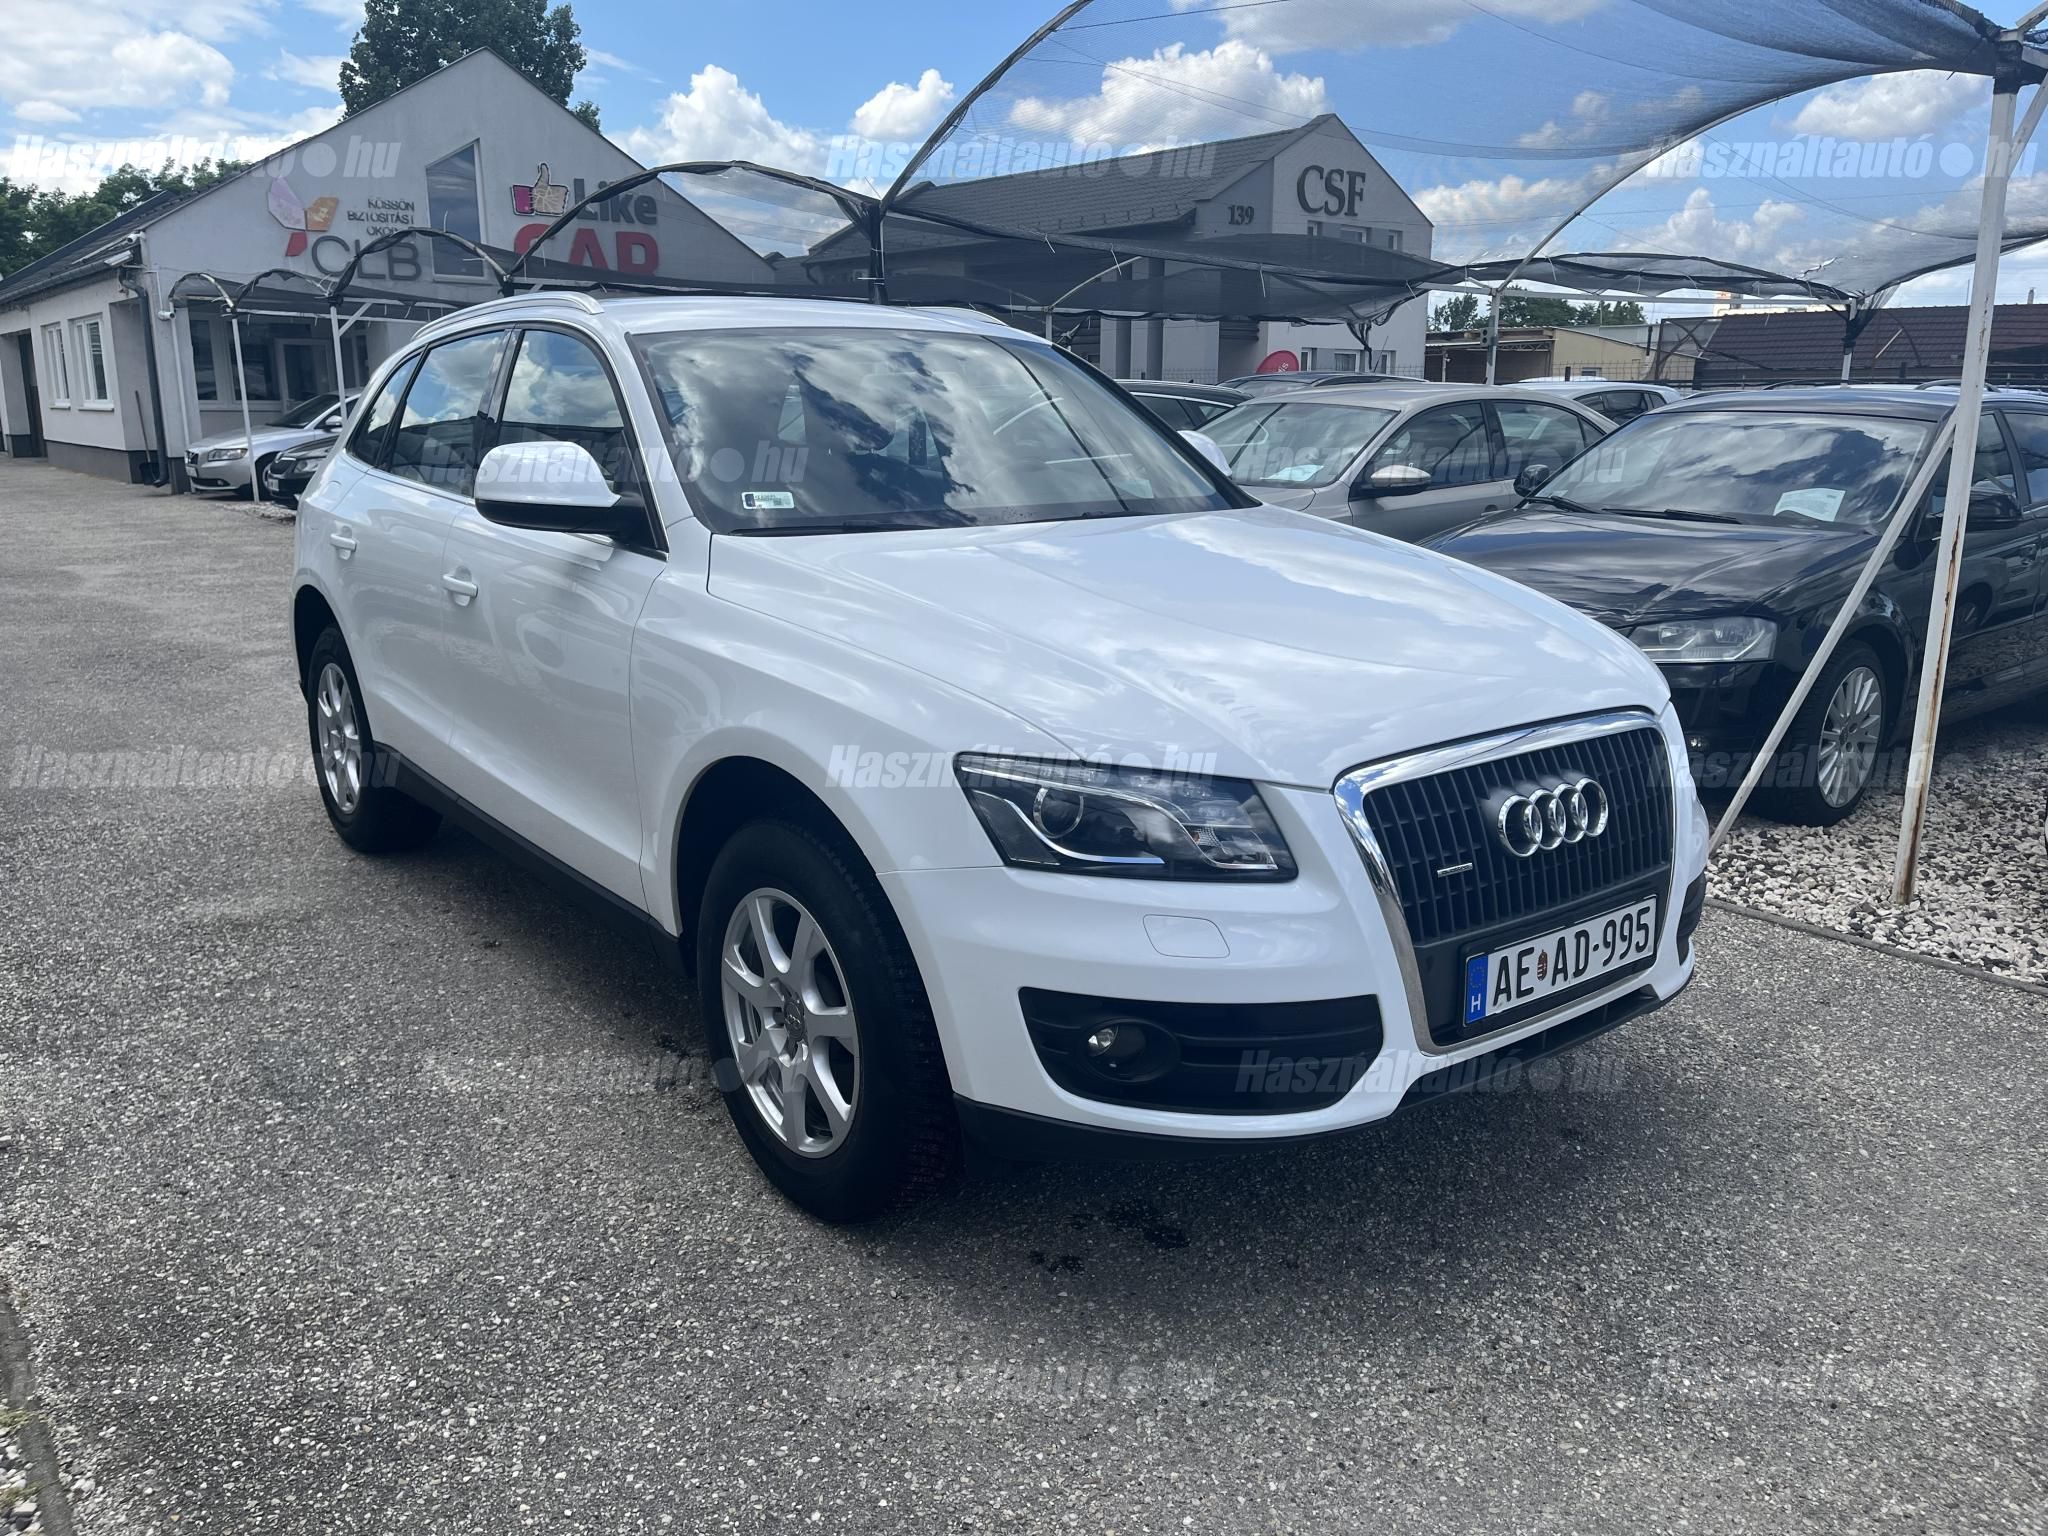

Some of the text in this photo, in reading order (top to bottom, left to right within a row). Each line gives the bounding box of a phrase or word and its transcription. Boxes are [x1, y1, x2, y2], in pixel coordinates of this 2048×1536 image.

[573, 178, 657, 225] Like
[1296, 165, 1367, 217] CSF
[1228, 204, 1255, 225] 139
[311, 235, 422, 281] CLB
[1493, 905, 1651, 1007] AE AD-995
[1470, 993, 1482, 1014] H
